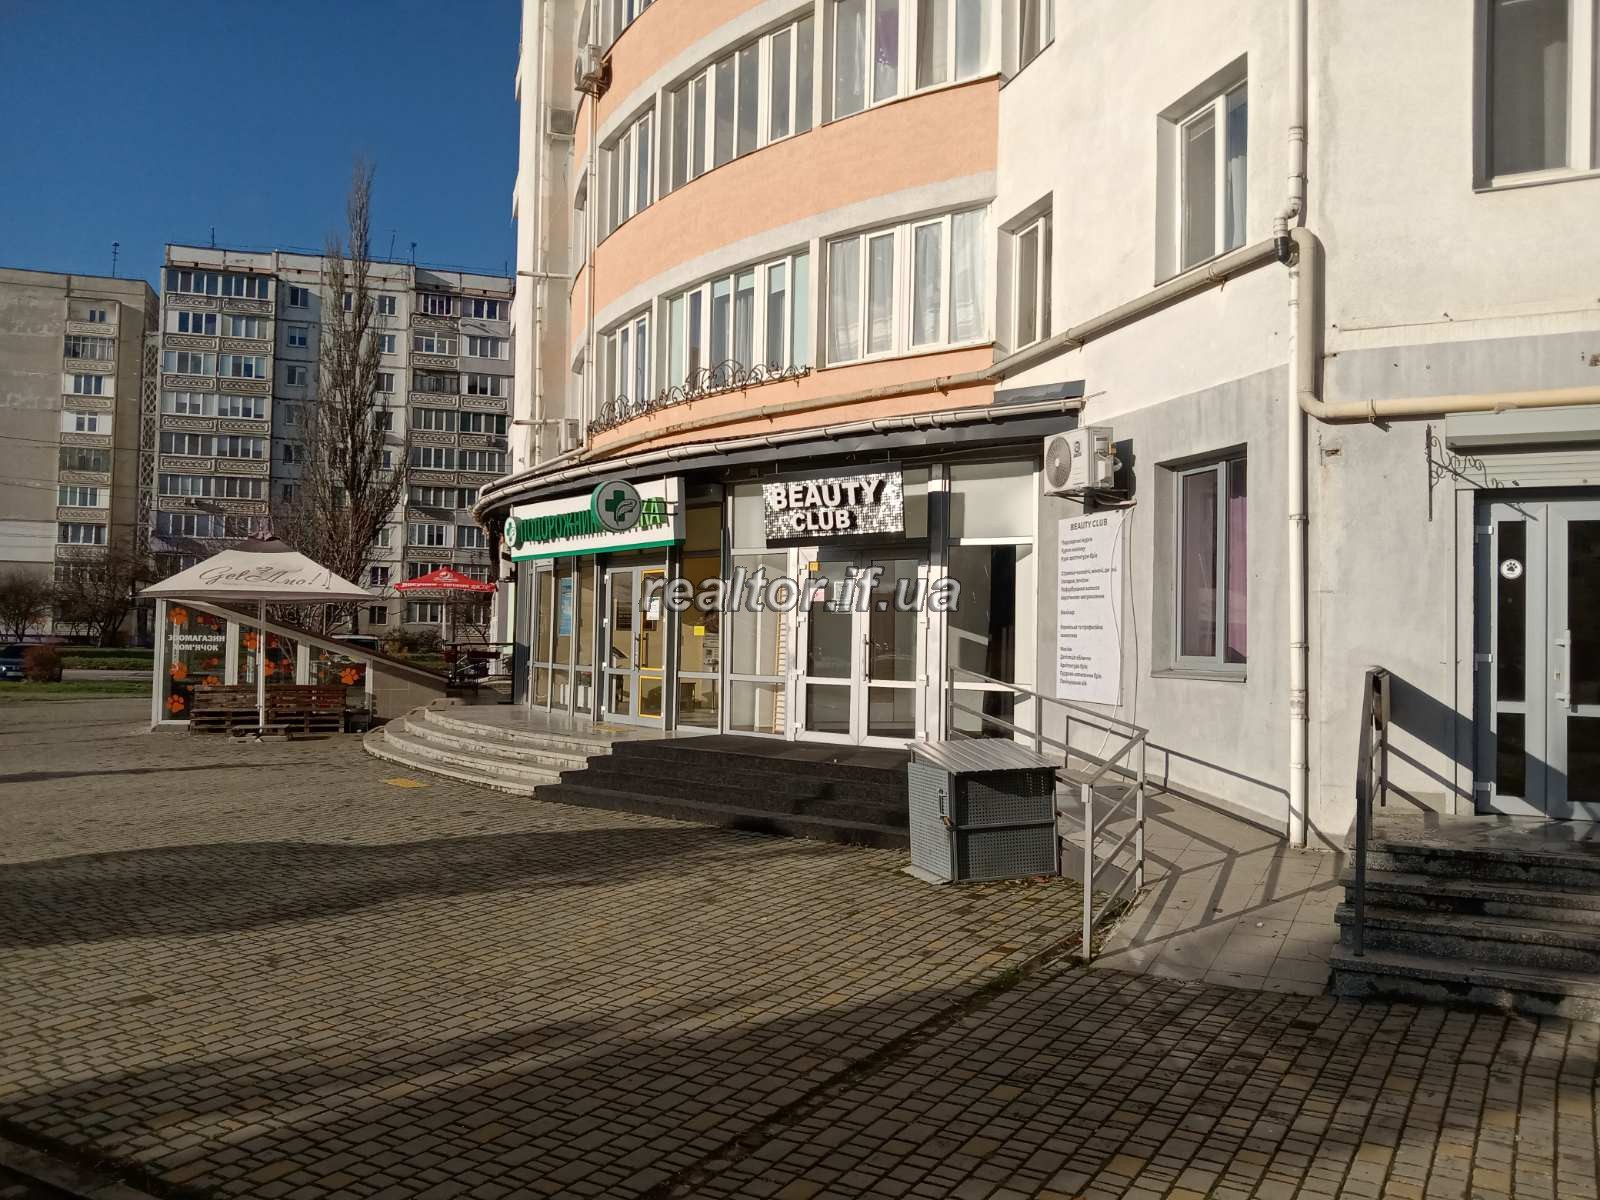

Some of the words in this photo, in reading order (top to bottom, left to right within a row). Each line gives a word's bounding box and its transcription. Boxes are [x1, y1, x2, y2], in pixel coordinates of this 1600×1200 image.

[773, 479, 882, 511] BEAUTY
[791, 510, 851, 532] CLUB
[1070, 520, 1091, 531] BEAUTY
[1092, 518, 1108, 528] CLUB
